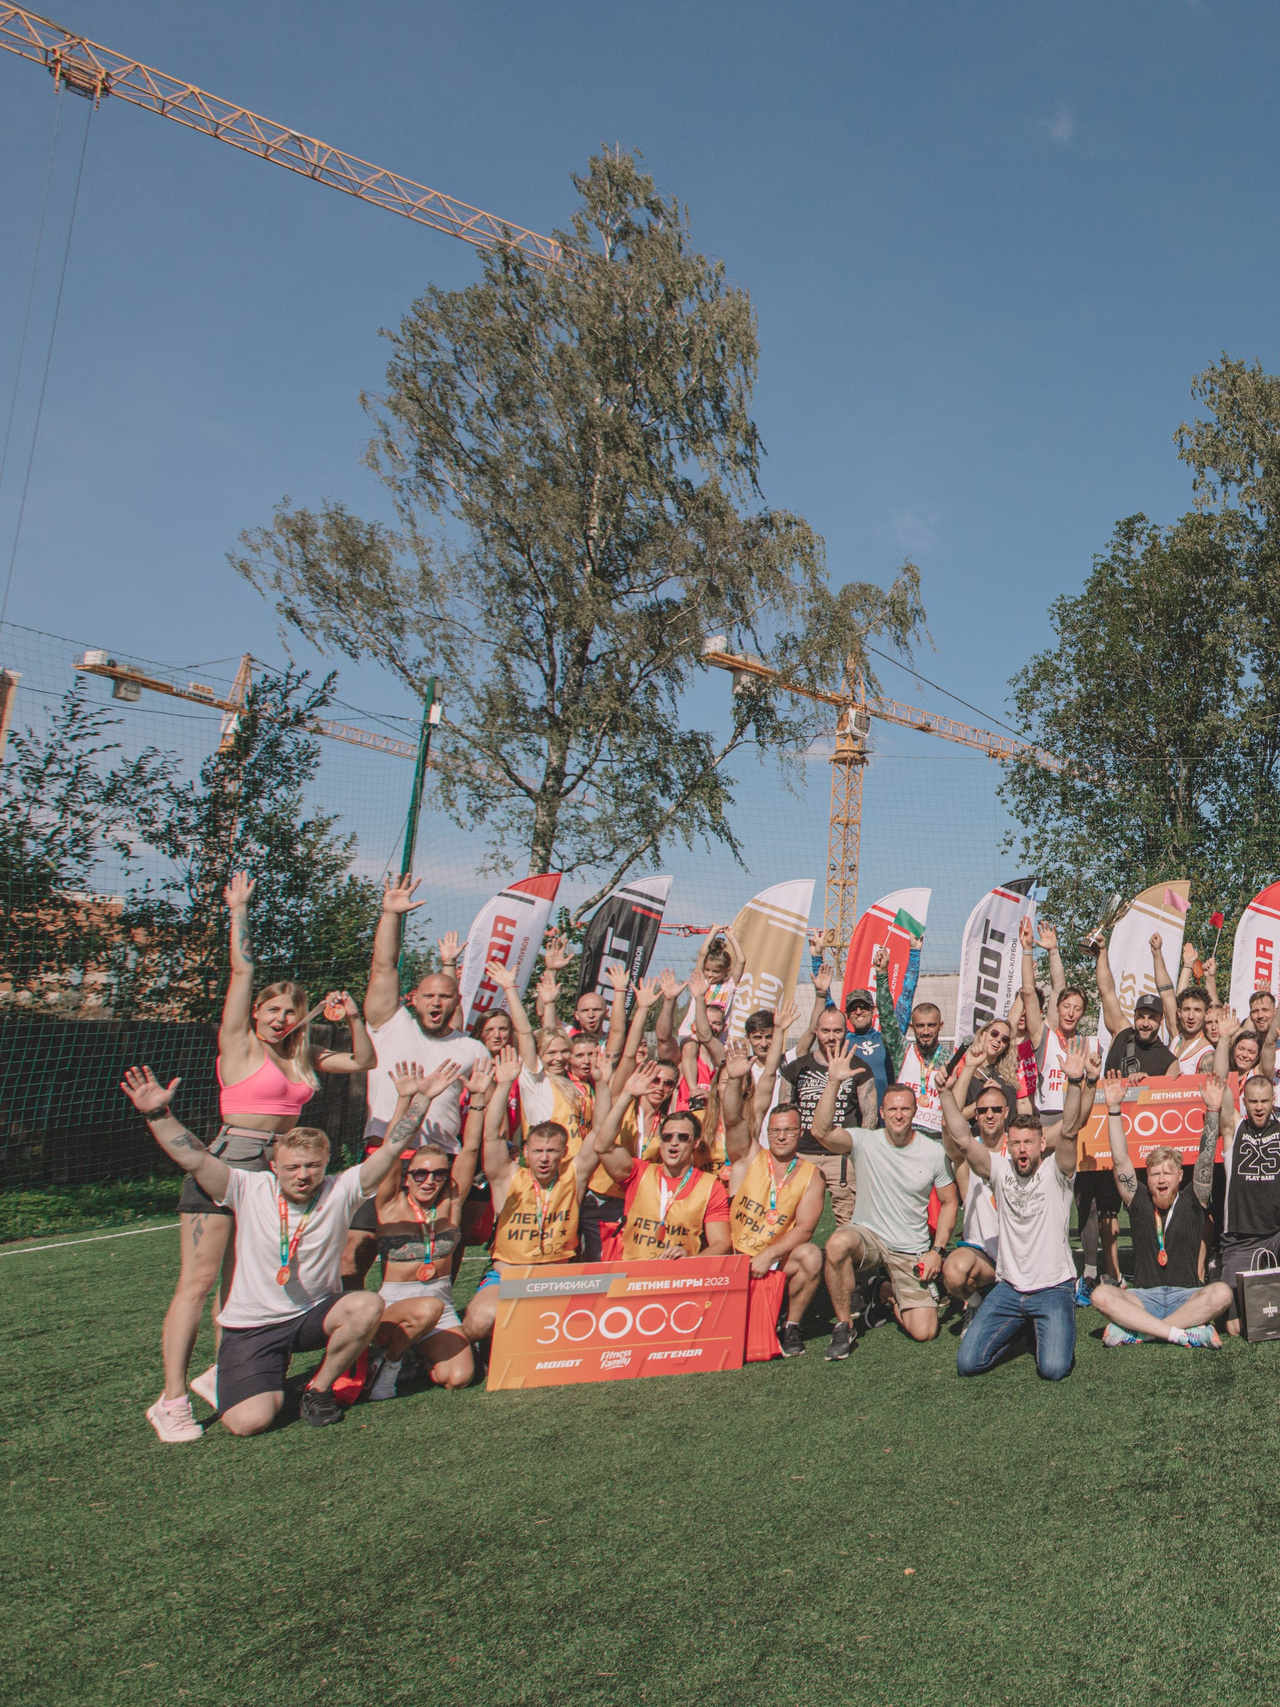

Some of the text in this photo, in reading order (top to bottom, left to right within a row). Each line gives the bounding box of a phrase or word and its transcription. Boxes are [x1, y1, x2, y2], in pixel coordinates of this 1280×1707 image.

[1151, 1091, 1182, 1100] ЛЕТНИЕ
[739, 1196, 788, 1226] ЛЕТНЕ
[735, 1210, 766, 1234] ИГРЫ
[508, 1228, 555, 1241] ИГРЫ
[526, 1279, 602, 1293] СЕРТИФИКАТ
[626, 1276, 730, 1292] ЛЕТНИЕ ИГРЫ 2023
[601, 1349, 633, 1362] Fitness
[647, 1348, 703, 1361] ЛЕГЕНДА
[535, 1359, 583, 1370] МОЛОТ
[601, 1356, 632, 1369] Family
